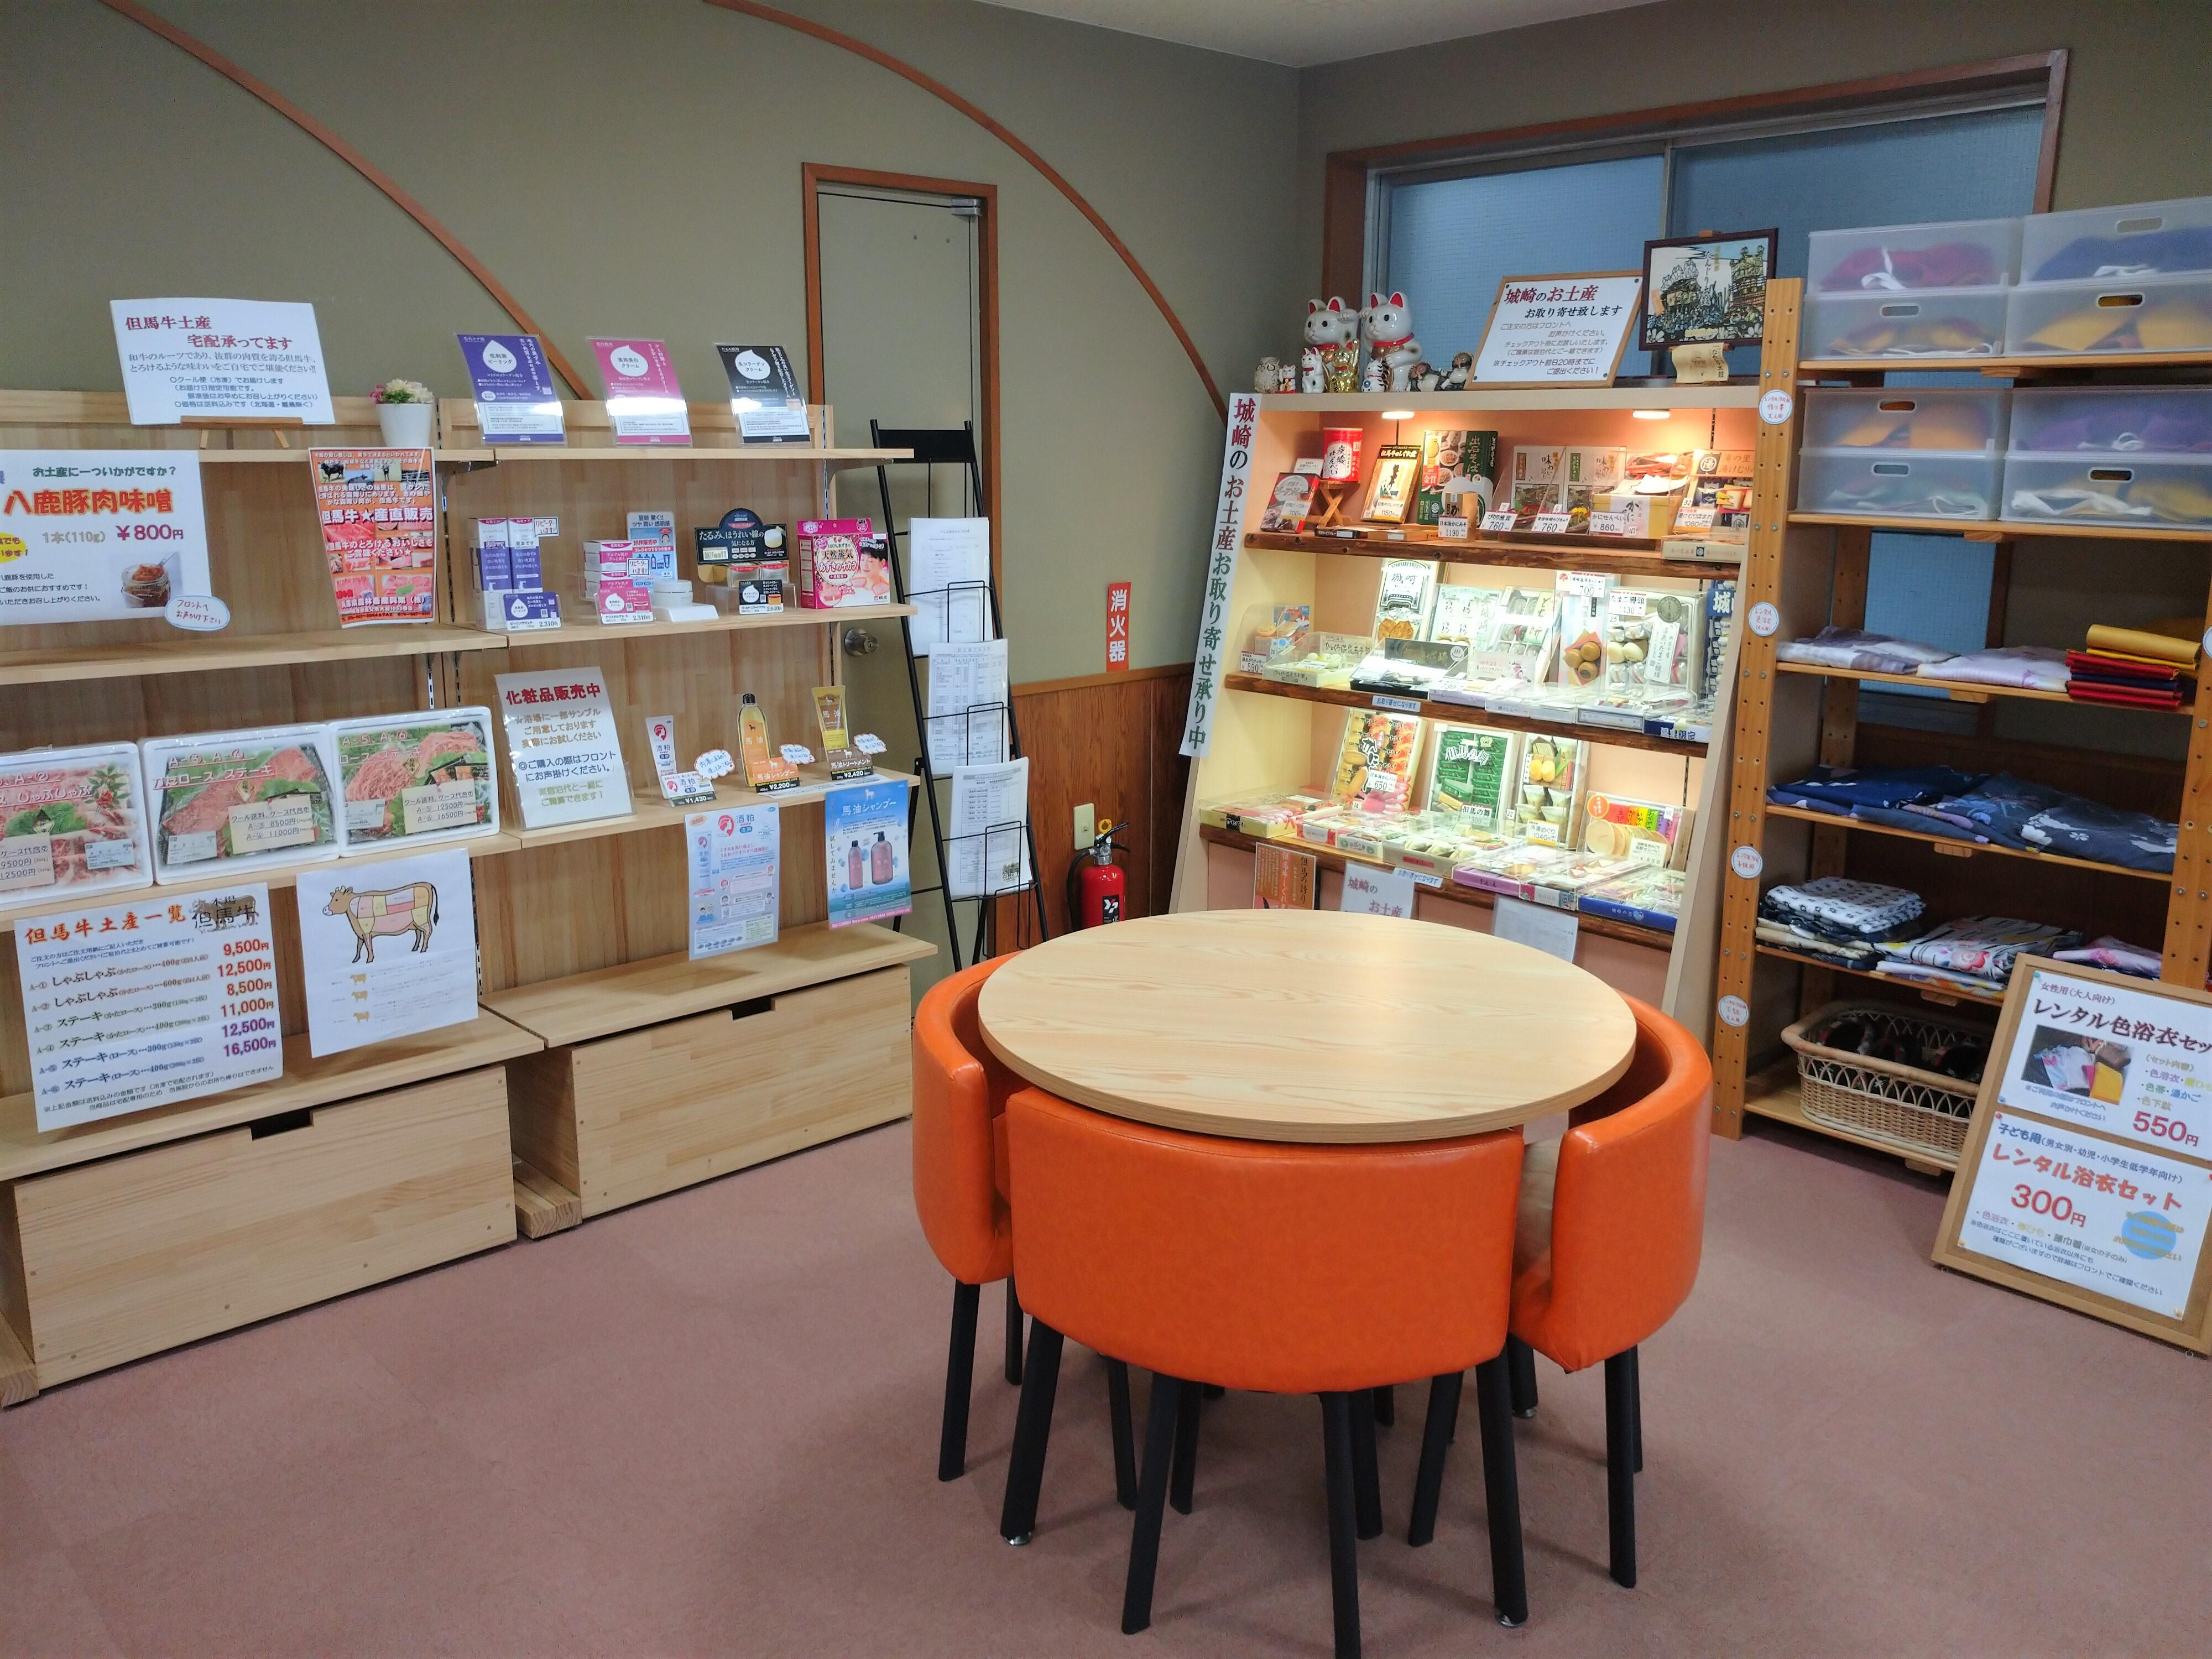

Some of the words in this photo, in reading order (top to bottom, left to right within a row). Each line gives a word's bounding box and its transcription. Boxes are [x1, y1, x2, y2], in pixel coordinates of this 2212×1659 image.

[1504, 284, 1599, 304] 城崎のお土産
[1525, 305, 1623, 319] お取り寄せ致します
[126, 316, 212, 330] 但馬牛土産
[187, 335, 293, 349] 宅配承ってます
[33, 466, 176, 478] お土産に一ついかがですか？
[4, 489, 174, 515] 八鹿豚肉味噌
[1446, 529, 1460, 537] 1190
[1488, 521, 1504, 531] 760
[1542, 523, 1558, 532] 760
[699, 529, 765, 541] たるみ、ほうれい線の
[819, 560, 857, 573] あずきのチカラ
[1188, 397, 1257, 751] 城崎のお土産お取り寄せ承り中
[1610, 595, 1645, 604] たまご饅頭
[1109, 588, 1128, 663] 消火器
[1247, 663, 1259, 673] 590
[505, 683, 601, 706] 化粧品販売中
[339, 752, 371, 764] ロース
[382, 747, 422, 760] ステーキ
[1445, 744, 1489, 766] 但馬の舞
[225, 764, 273, 778] ステーキ
[830, 759, 872, 770] 馬油トリートメント
[757, 770, 796, 781] 馬油シャンプー
[843, 770, 864, 779] ¥2,420
[18, 784, 91, 802] しゃぶしゃぶ
[769, 781, 790, 791] ¥2,200
[1374, 780, 1387, 790] 650
[685, 795, 707, 804] ¥1,430
[842, 798, 898, 817] 馬油シャンプー
[736, 813, 755, 824] 酒粕
[1462, 806, 1490, 817] 但馬の舞
[1347, 876, 1378, 894] 城崎の
[24, 904, 187, 946] 但馬牛土産一覧
[223, 938, 270, 957] 9,500円
[217, 958, 272, 978] 12,500円
[227, 978, 273, 997] 8,500円
[2039, 981, 2116, 1006] 女性用(大人向け)
[220, 998, 274, 1018] 11,000円
[221, 1018, 275, 1037] 12,500円
[223, 1037, 276, 1057] 16,500円
[2132, 1110, 2199, 1147] 550円
[1992, 1142, 2182, 1212] レンタル浴衣セット
[2011, 1183, 2086, 1228] 300円
